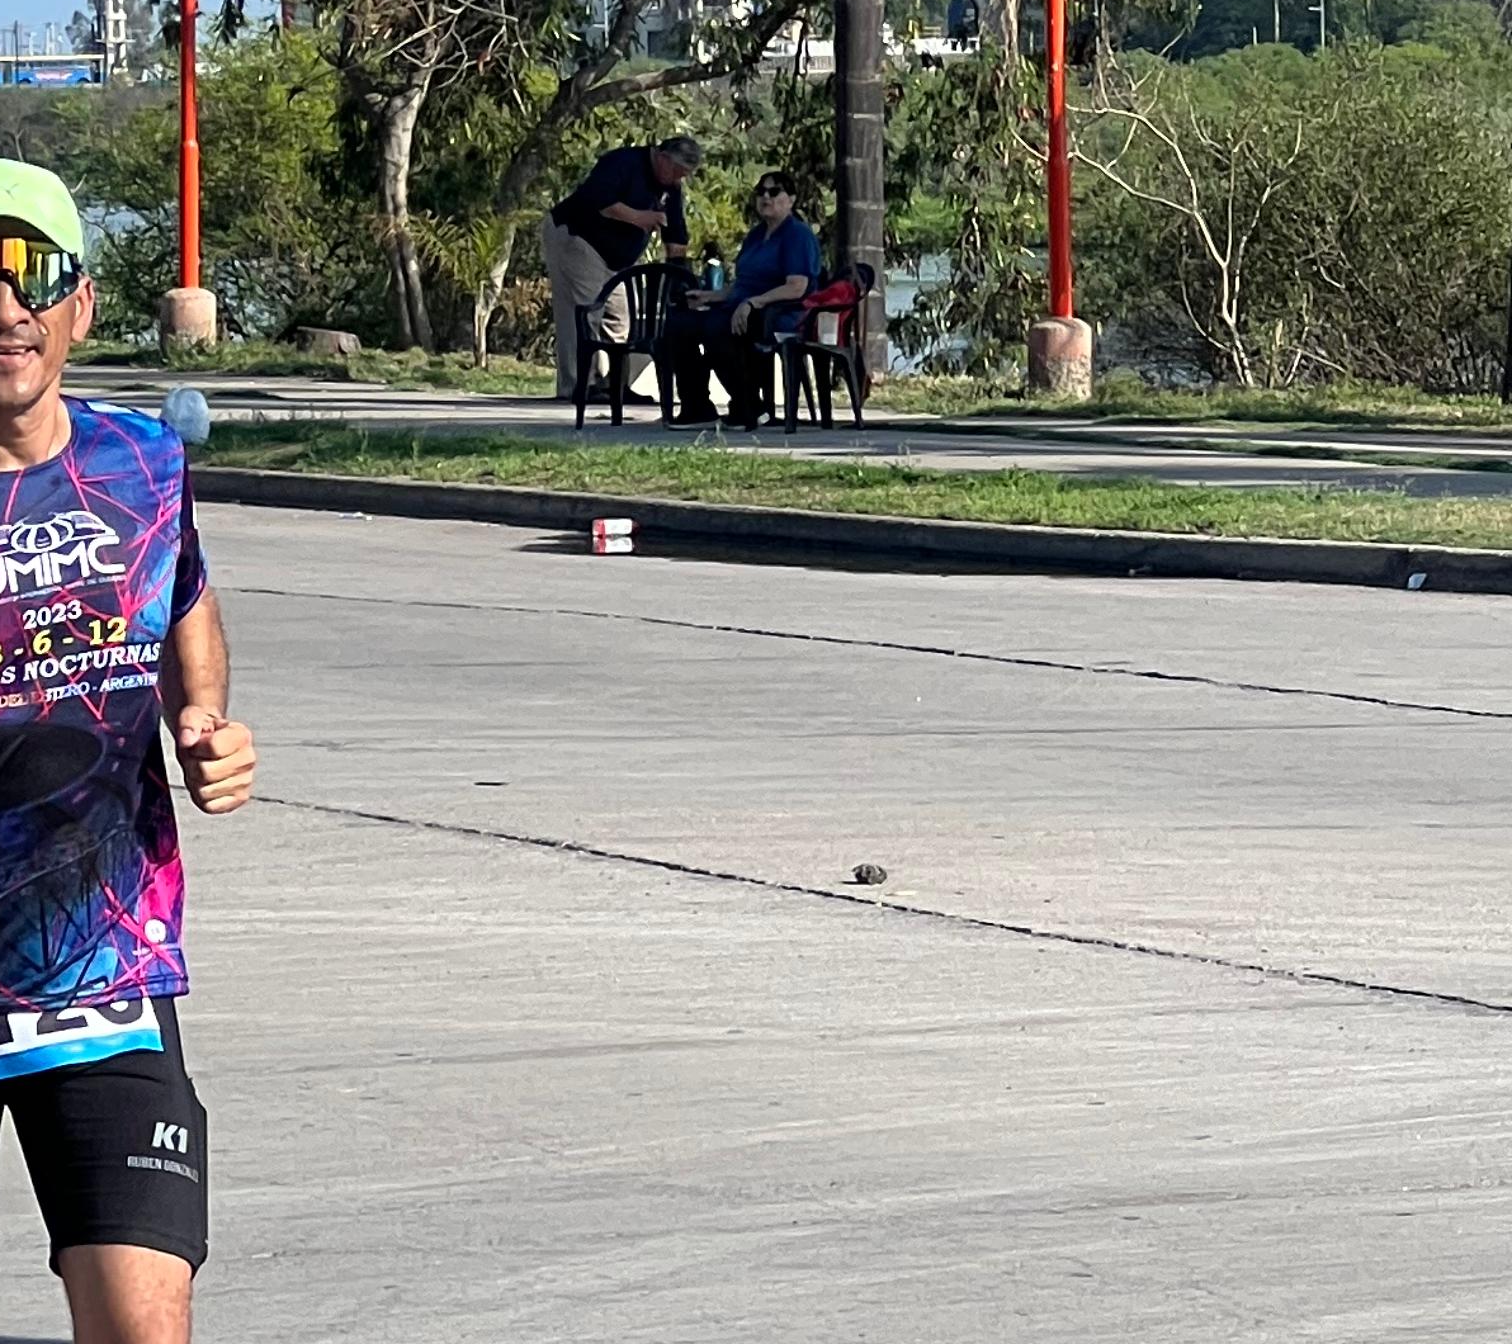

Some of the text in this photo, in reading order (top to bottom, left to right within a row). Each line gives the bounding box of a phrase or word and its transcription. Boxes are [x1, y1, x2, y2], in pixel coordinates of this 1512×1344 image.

[22, 600, 83, 630] 2023
[32, 629, 52, 655] 6
[88, 617, 128, 646] 12
[22, 642, 161, 681] NOCTURNAS
[152, 1121, 188, 1154] K1
